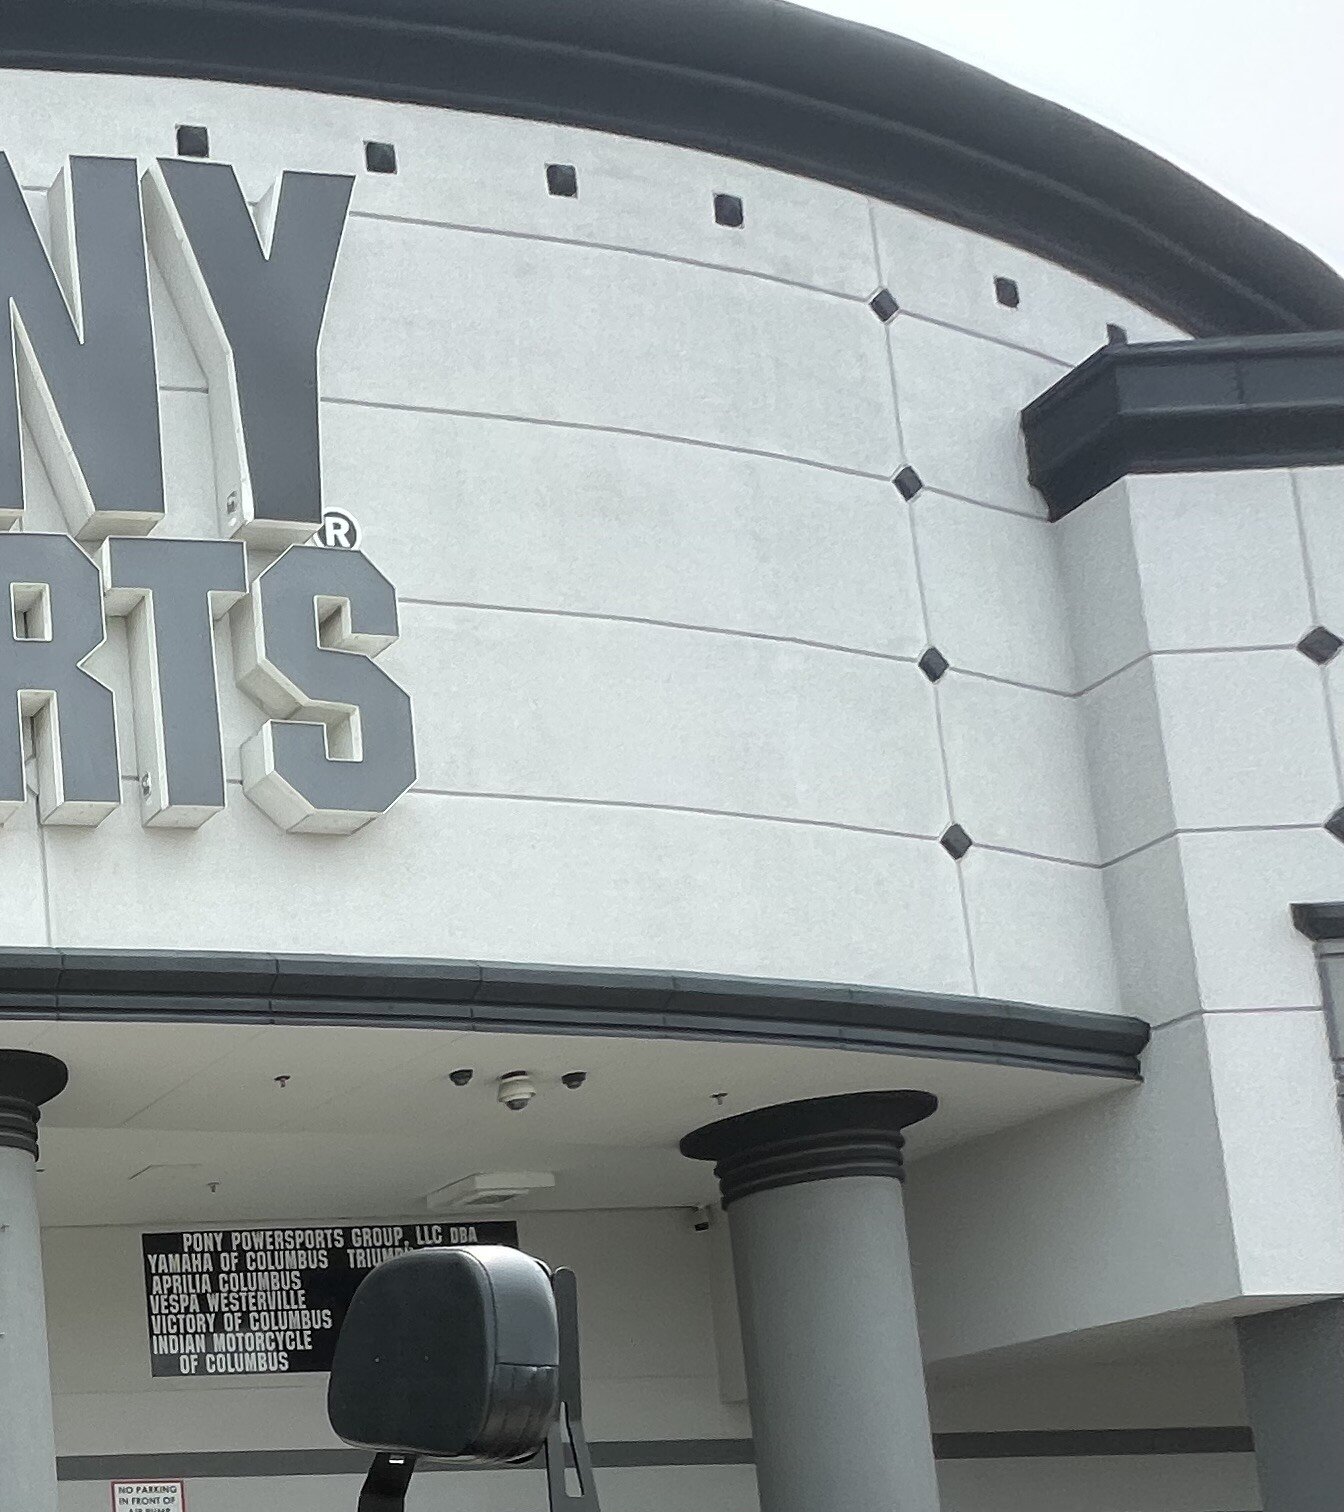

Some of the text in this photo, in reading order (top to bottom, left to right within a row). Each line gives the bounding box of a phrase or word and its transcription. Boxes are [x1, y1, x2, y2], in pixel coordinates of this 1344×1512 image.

[183, 1225, 479, 1253] PONY POWERSPORTS GROUP, LLC DBA
[148, 1253, 213, 1274] YAMAHA
[220, 1252, 239, 1271] OF
[246, 1249, 329, 1271] COLUMBUS
[152, 1271, 302, 1294] APRILIA COLUMBUS
[149, 1290, 306, 1314] VESPA WESTERVILLE
[151, 1309, 333, 1334] VICTORY OF COLUMBUS
[152, 1330, 313, 1354] INDIAN MOTORCYCLE
[179, 1351, 289, 1374] OF COLUMBUS
[118, 1485, 177, 1494] NO PARKING
[119, 1496, 176, 1505] IN FRONT OF
